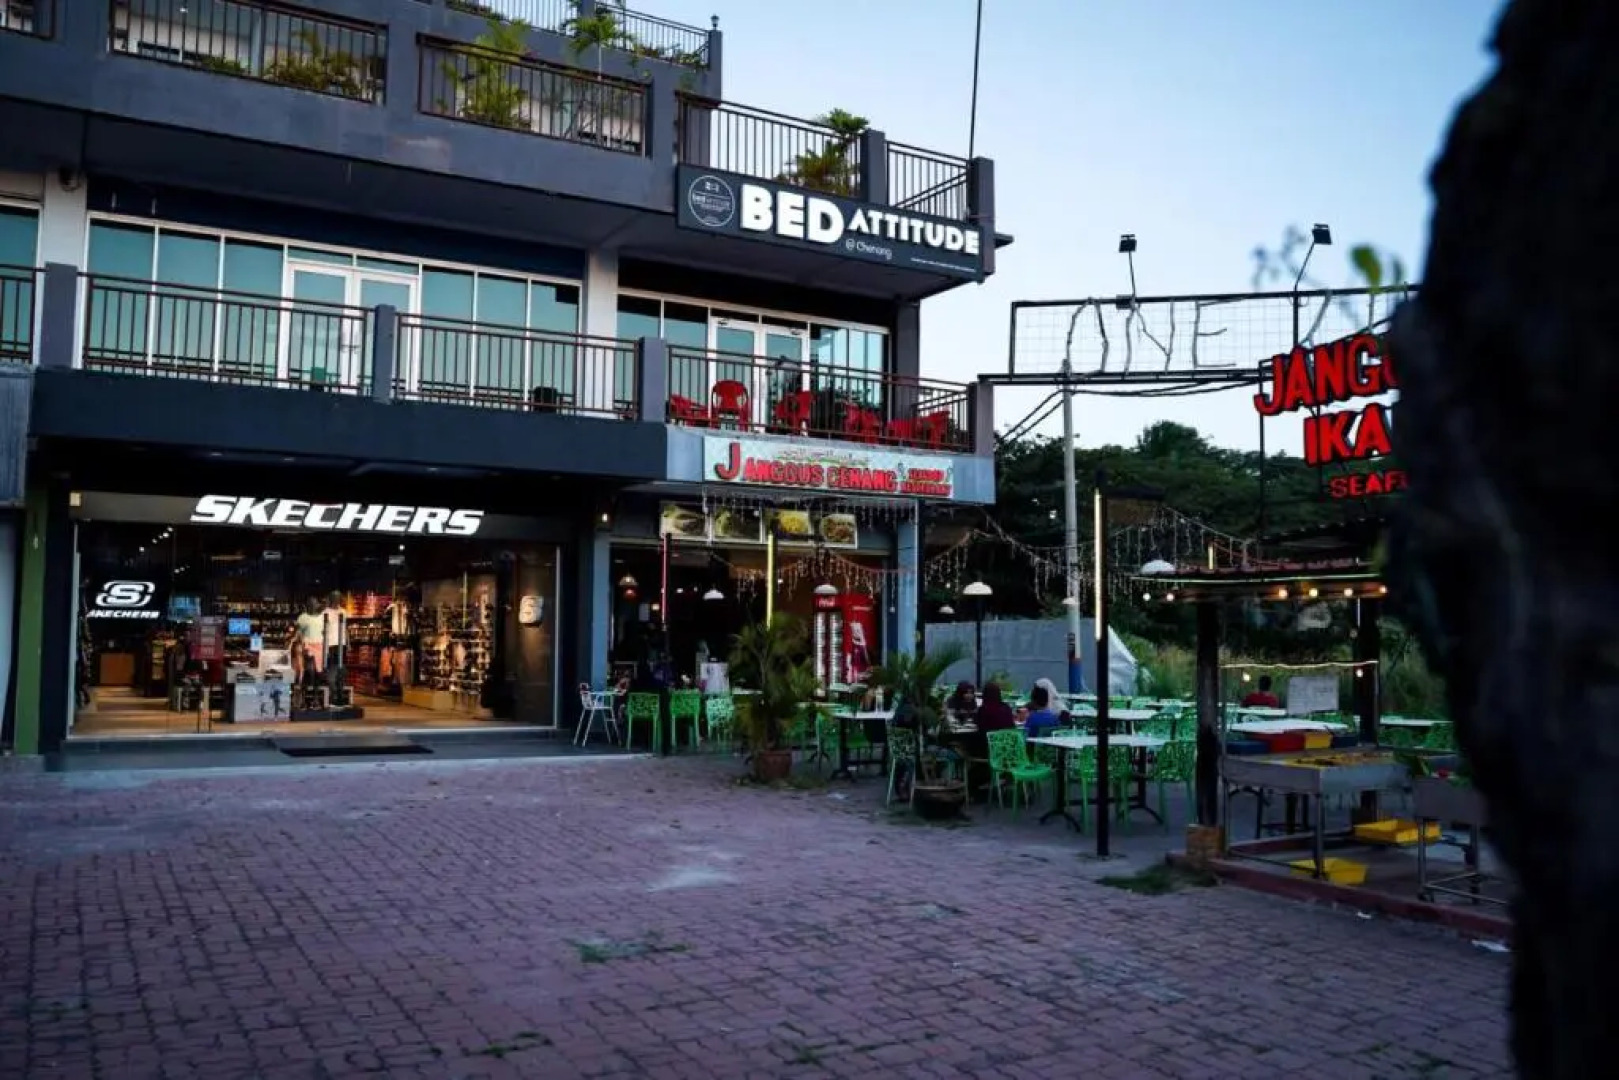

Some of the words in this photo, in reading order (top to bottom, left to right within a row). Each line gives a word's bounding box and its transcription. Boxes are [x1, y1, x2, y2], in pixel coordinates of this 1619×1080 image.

[740, 183, 845, 243] BED
[848, 208, 979, 255] ATTITUDE
[190, 494, 484, 535] SKECHERS
